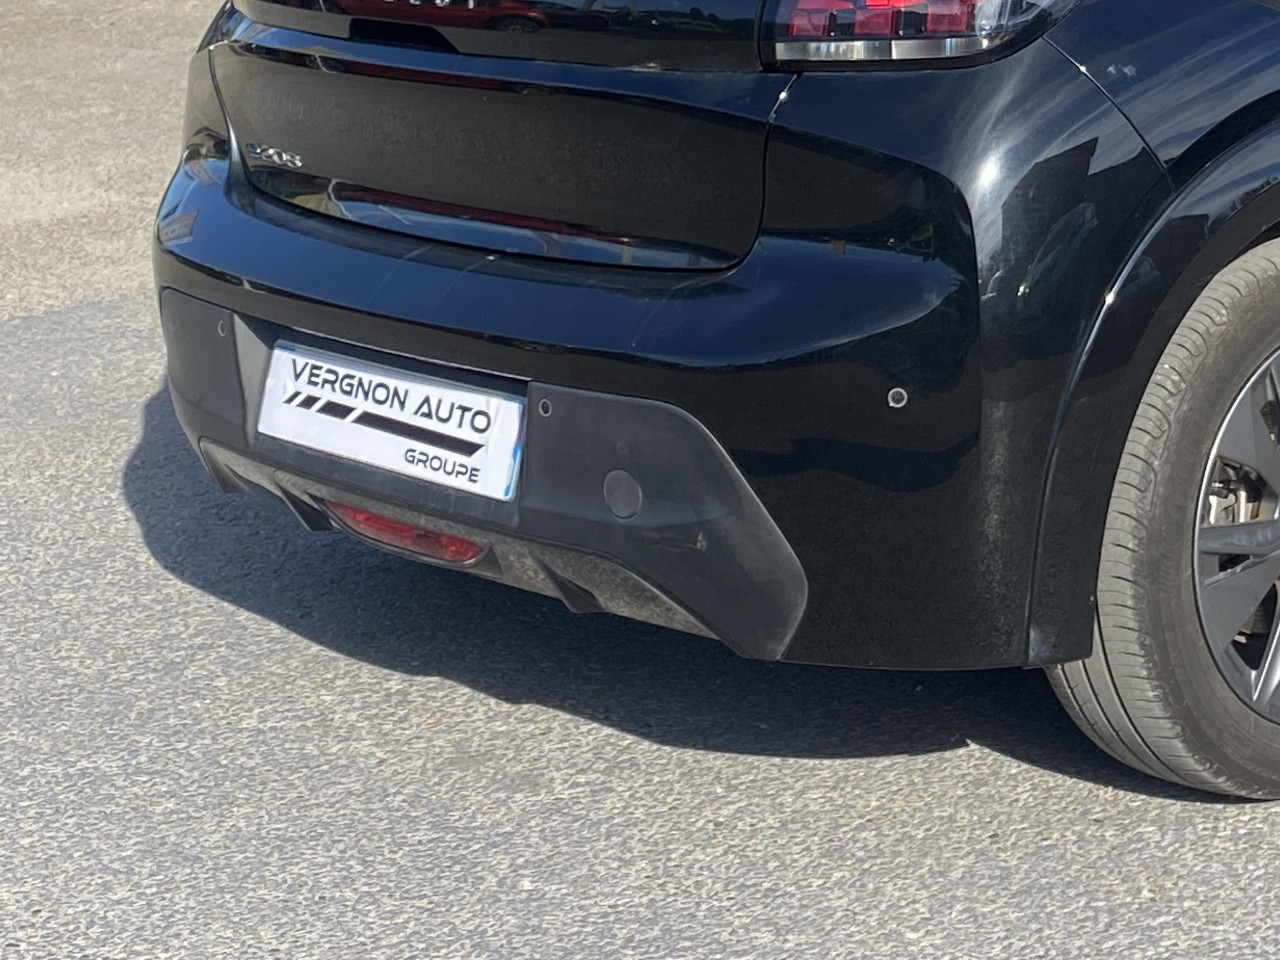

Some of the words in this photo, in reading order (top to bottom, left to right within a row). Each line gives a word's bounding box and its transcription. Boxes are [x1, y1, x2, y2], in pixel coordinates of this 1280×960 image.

[291, 358, 409, 412] VERGNON
[413, 395, 492, 434] AUTO
[404, 448, 482, 484] GROUPE
